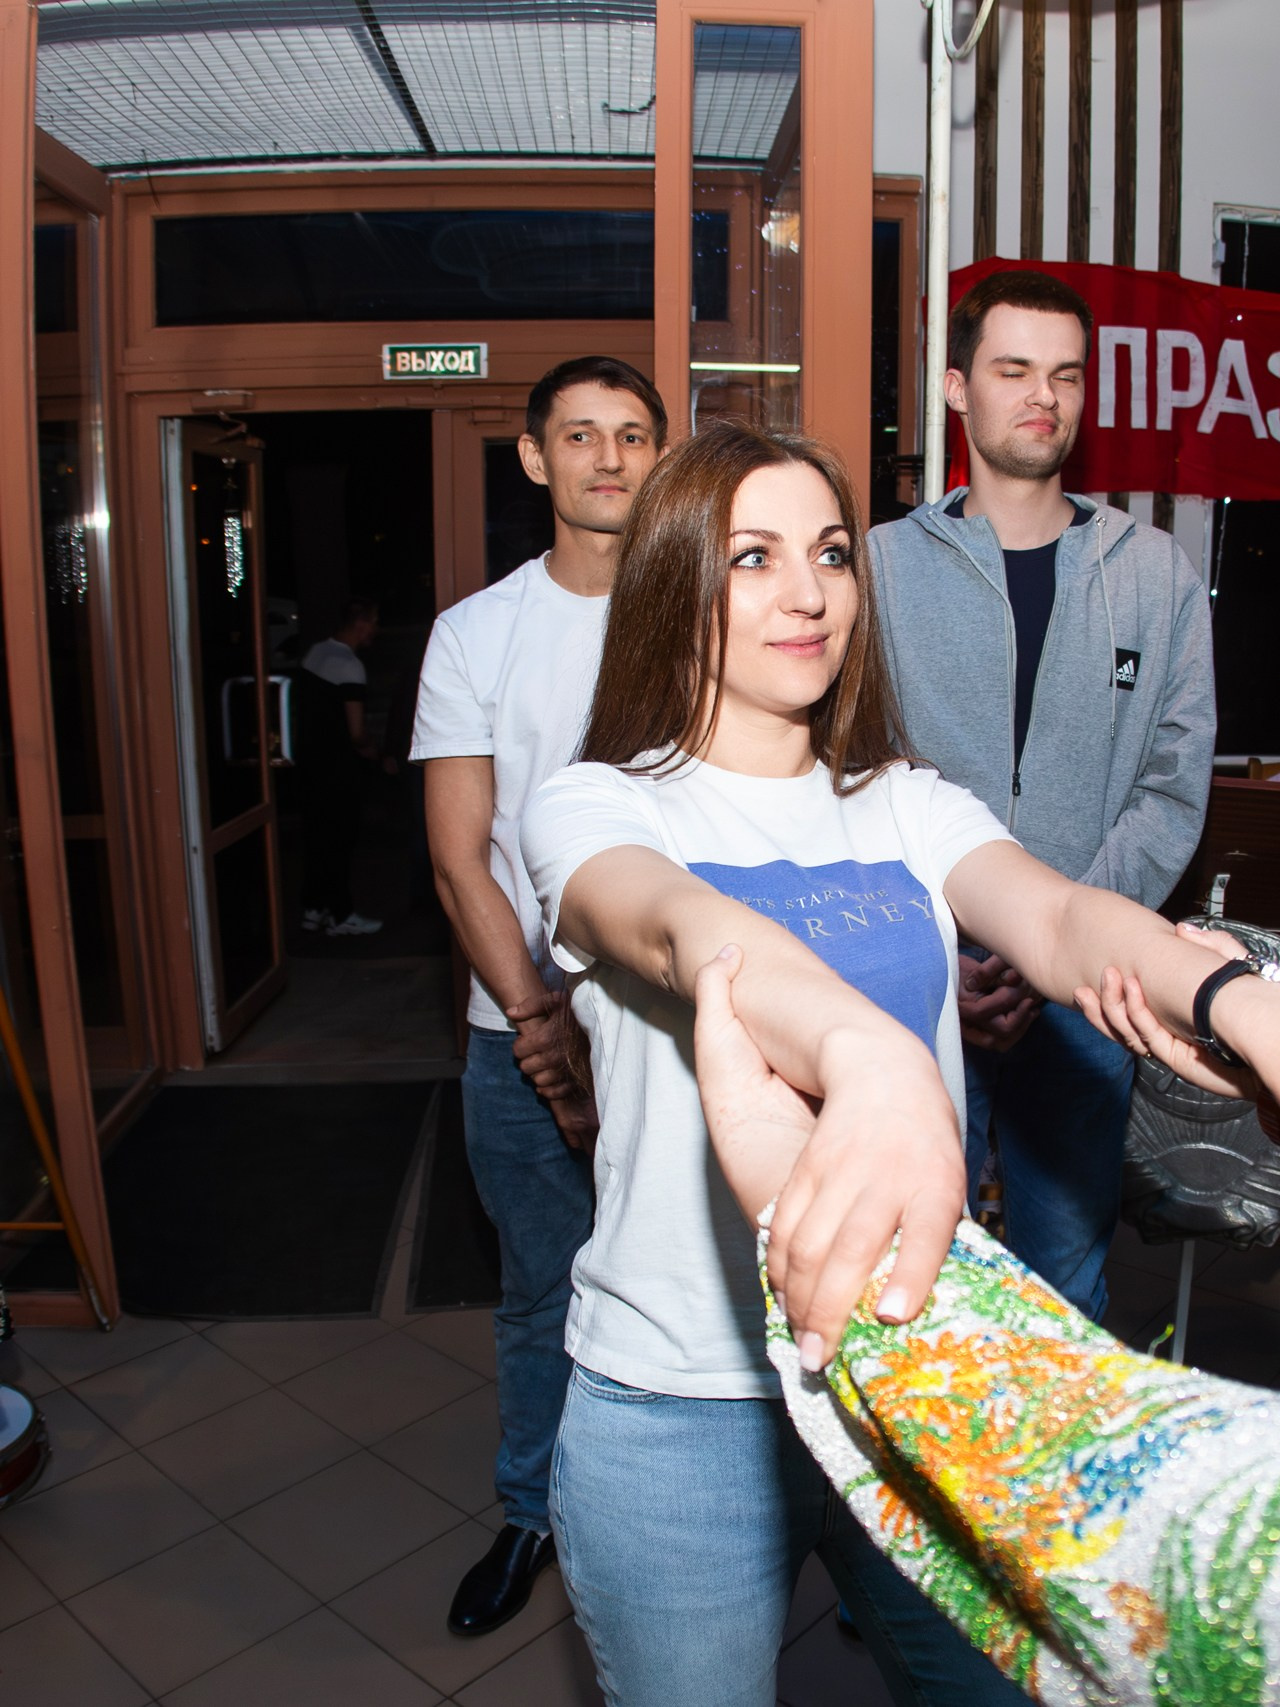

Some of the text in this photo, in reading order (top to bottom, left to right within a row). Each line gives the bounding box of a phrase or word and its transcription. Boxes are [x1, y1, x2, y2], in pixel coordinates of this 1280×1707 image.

[396, 350, 475, 373] ВЫХОД
[729, 888, 889, 910] ET'S START THE
